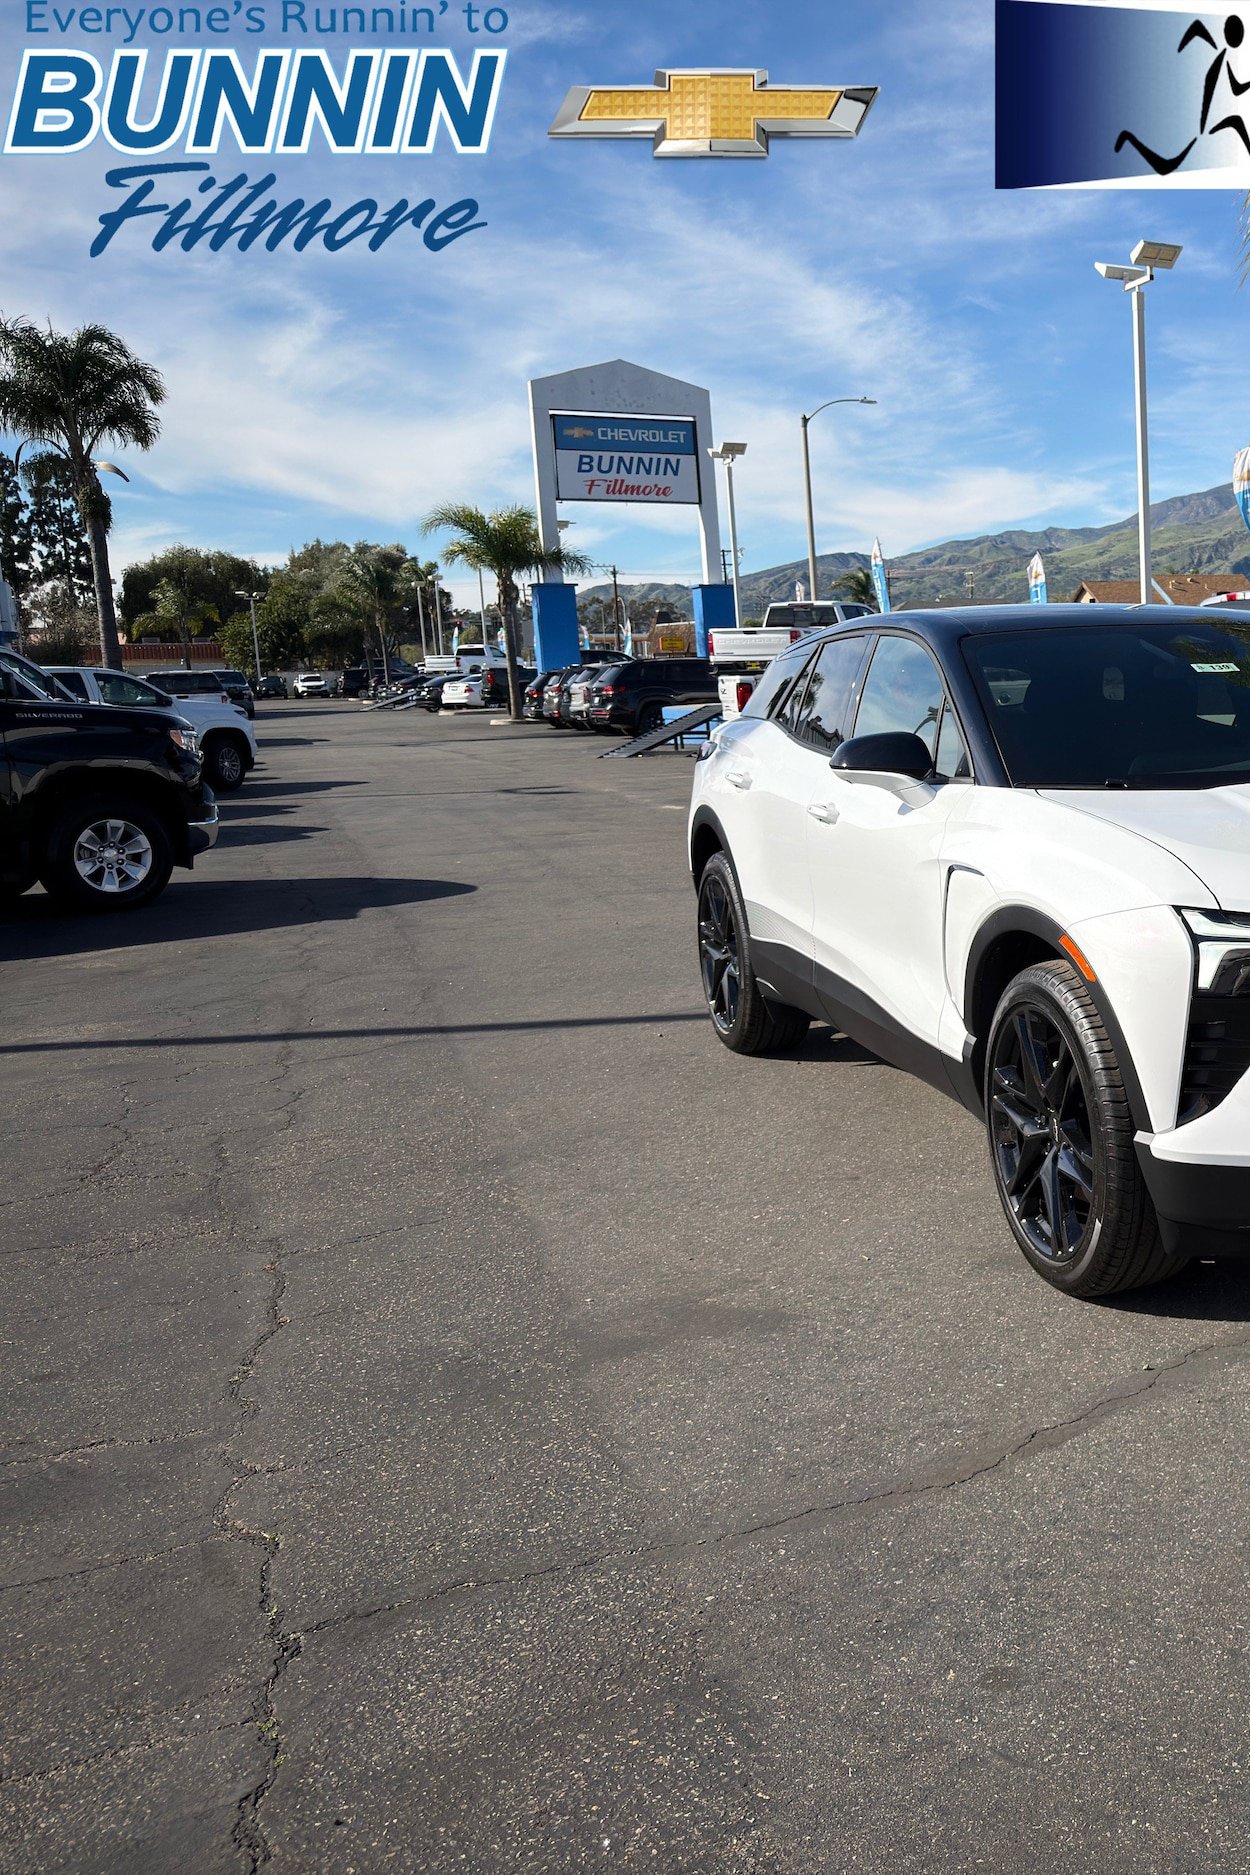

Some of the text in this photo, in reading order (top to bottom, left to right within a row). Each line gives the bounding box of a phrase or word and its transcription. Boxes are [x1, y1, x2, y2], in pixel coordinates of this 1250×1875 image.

[597, 427, 686, 444] CHEVROLET
[577, 454, 681, 476] BUNNIN
[584, 478, 673, 497] Fillmore
